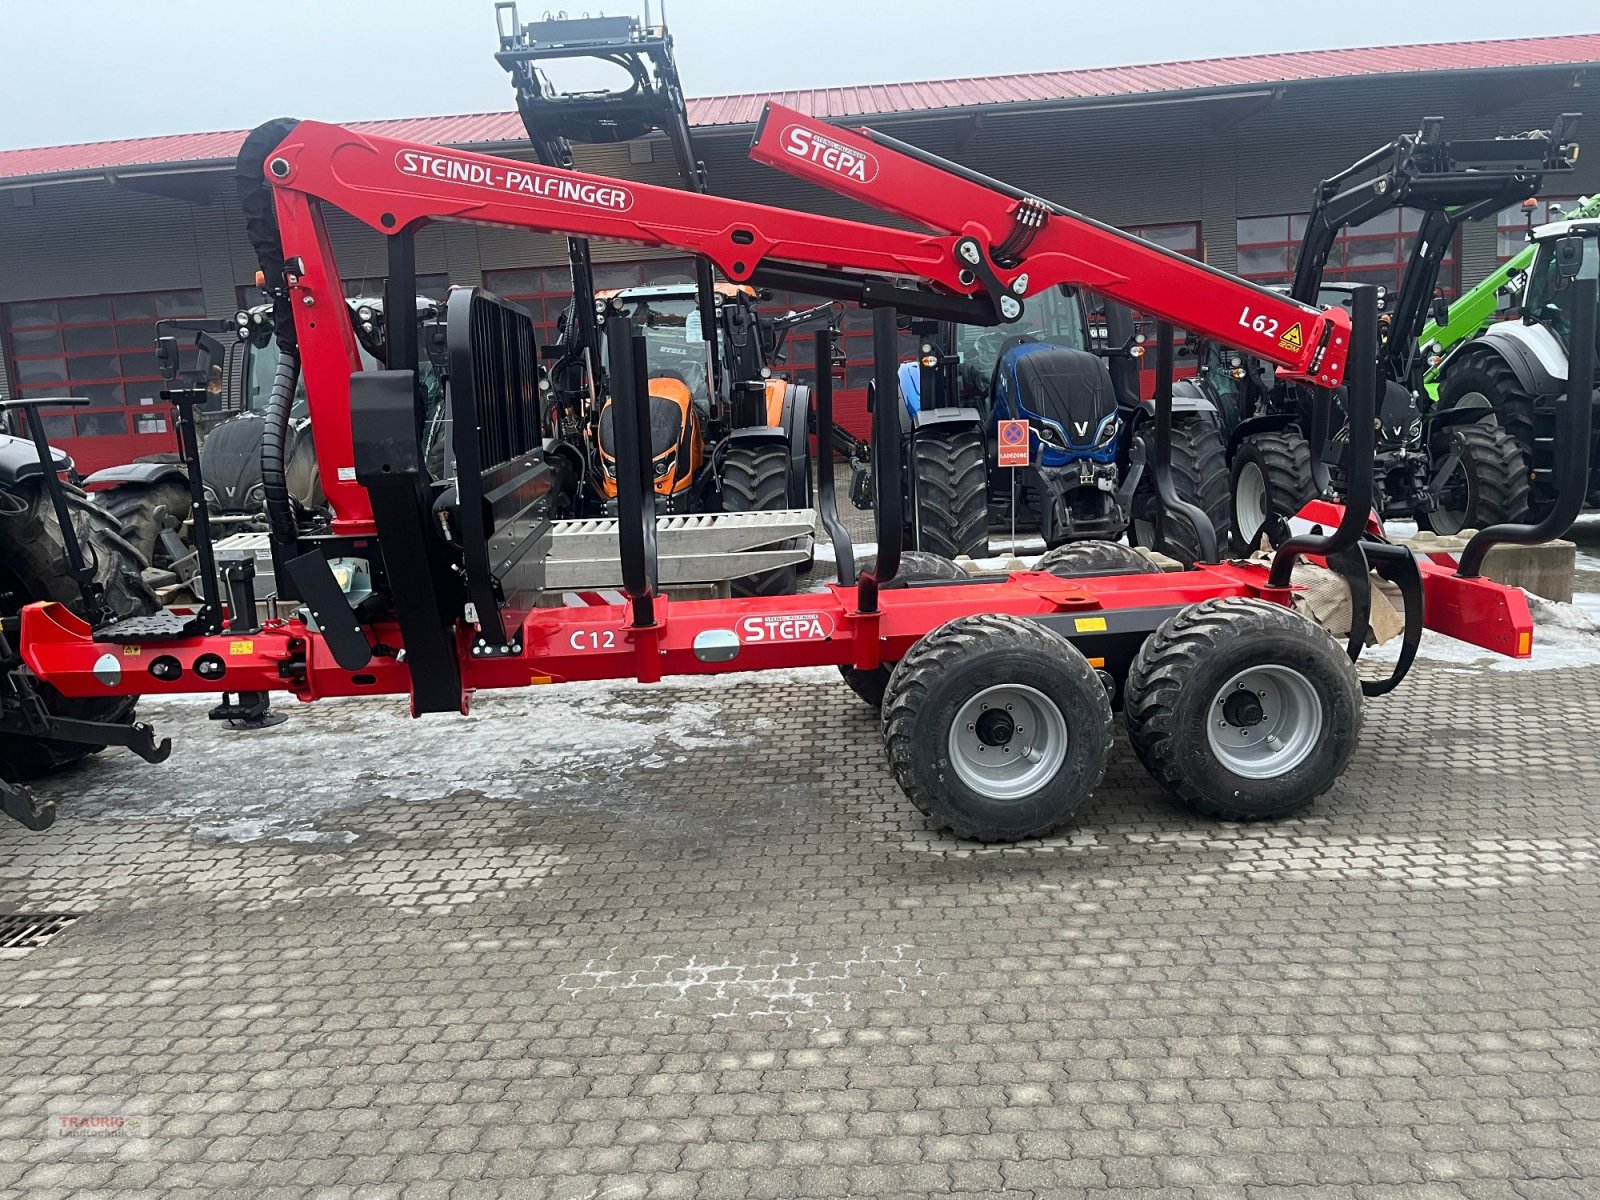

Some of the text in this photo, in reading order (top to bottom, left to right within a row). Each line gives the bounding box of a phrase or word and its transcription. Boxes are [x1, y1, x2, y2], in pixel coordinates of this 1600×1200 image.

[787, 128, 865, 182] STEPA
[403, 153, 626, 209] STEINDL-PALFINGER
[1239, 306, 1279, 338] L62
[743, 617, 826, 642] STEPA
